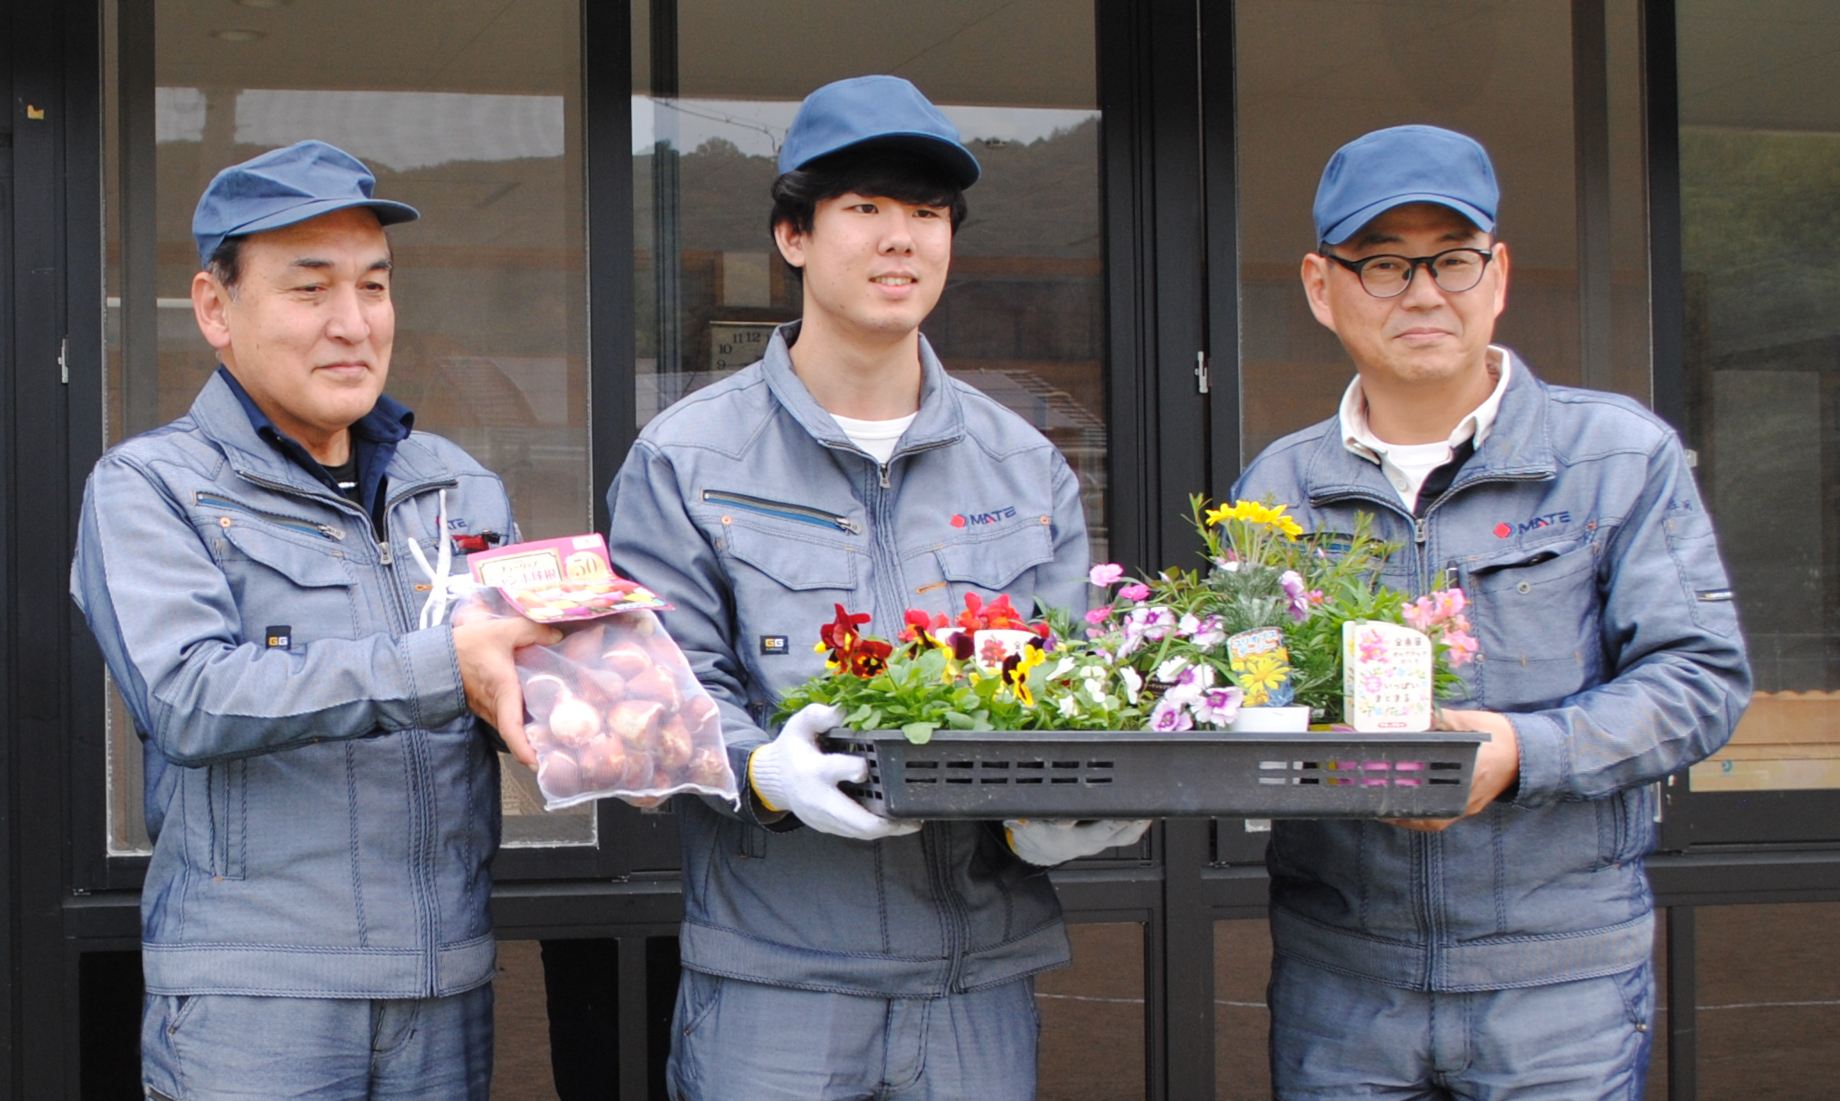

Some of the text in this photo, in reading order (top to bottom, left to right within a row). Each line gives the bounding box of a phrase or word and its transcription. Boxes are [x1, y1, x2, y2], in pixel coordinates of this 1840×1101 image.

[733, 333, 743, 343] 11
[746, 332, 760, 342] 12
[719, 343, 732, 354] 10
[716, 359, 726, 370] 9
[969, 505, 1017, 526] MATE
[1518, 510, 1571, 534] MATE
[573, 556, 598, 576] 50
